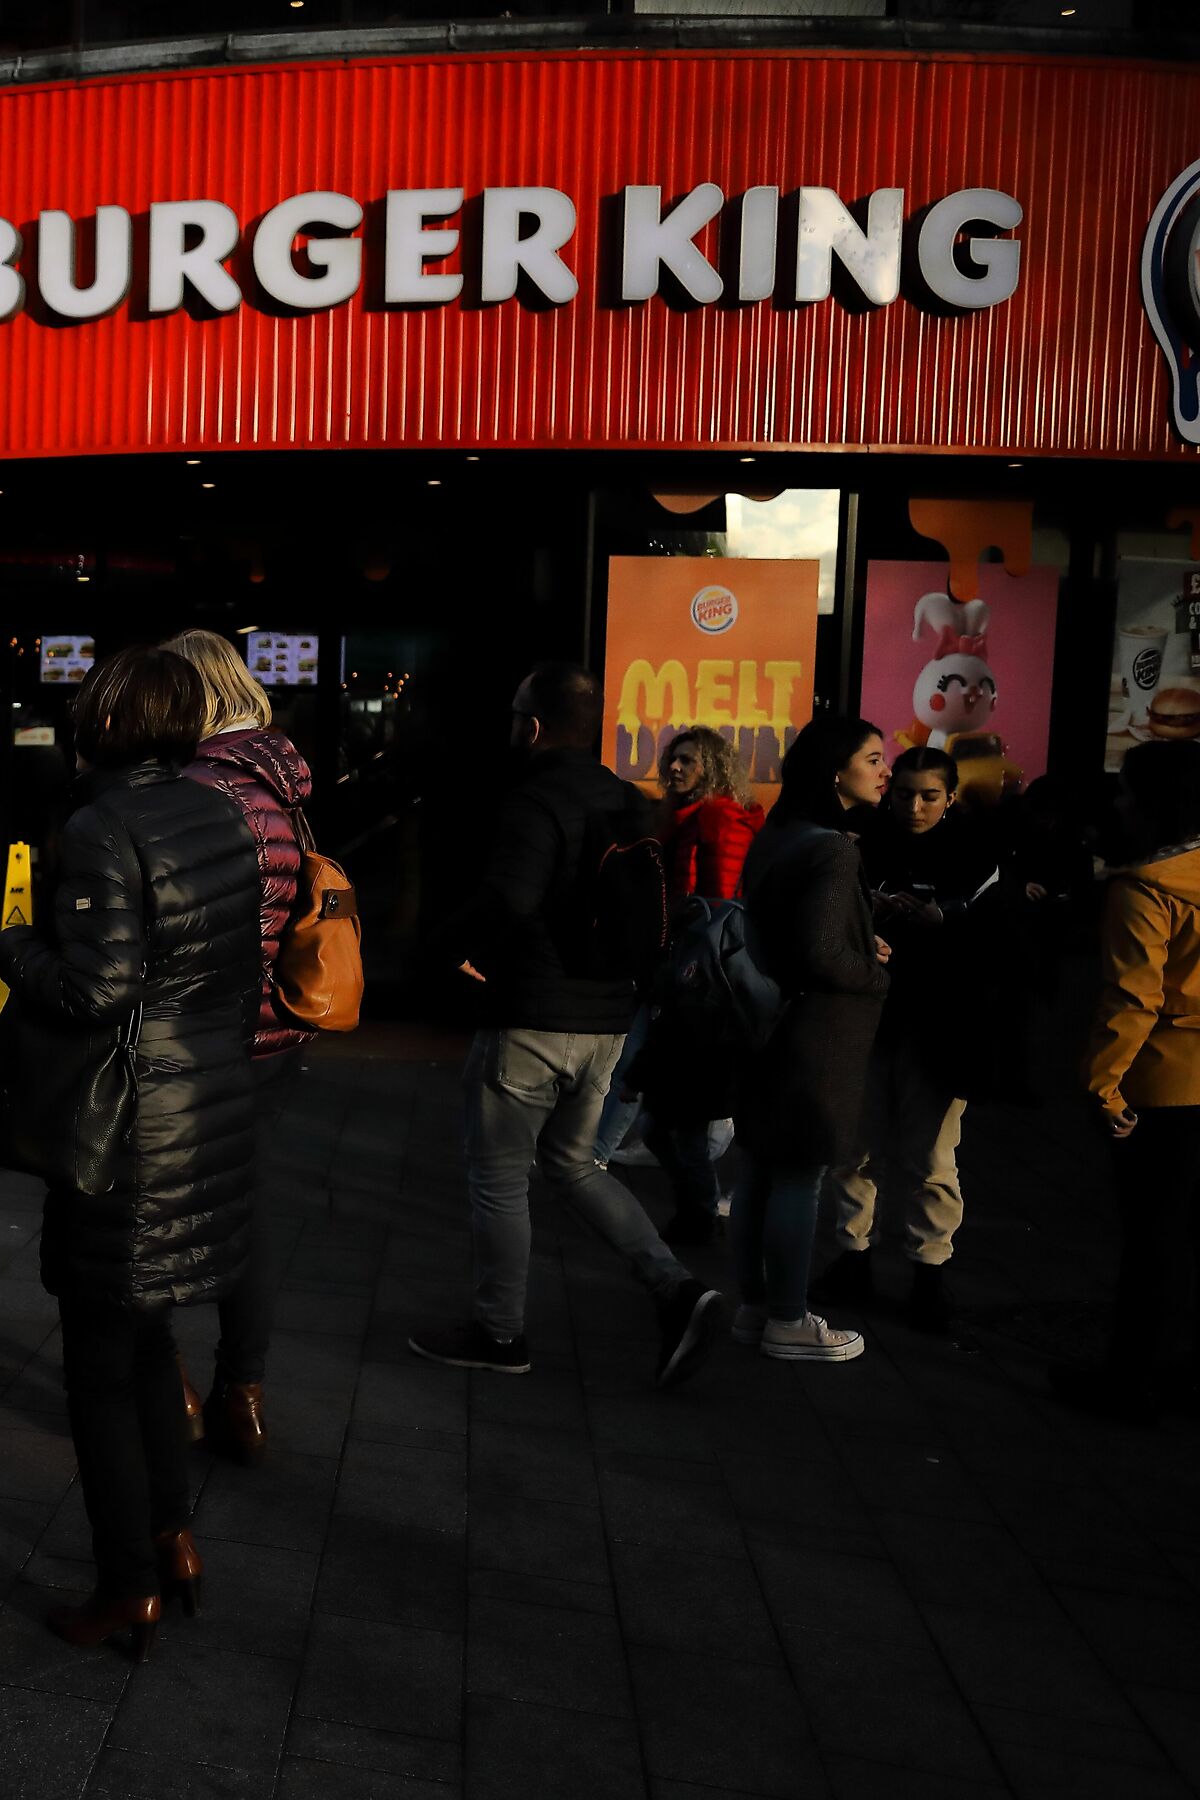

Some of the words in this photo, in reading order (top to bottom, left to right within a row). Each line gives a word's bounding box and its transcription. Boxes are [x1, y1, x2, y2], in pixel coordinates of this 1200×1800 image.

[622, 182, 1023, 308] KING
[697, 596, 731, 611] BURGER
[699, 604, 732, 622] KING
[617, 659, 801, 732] MELT
